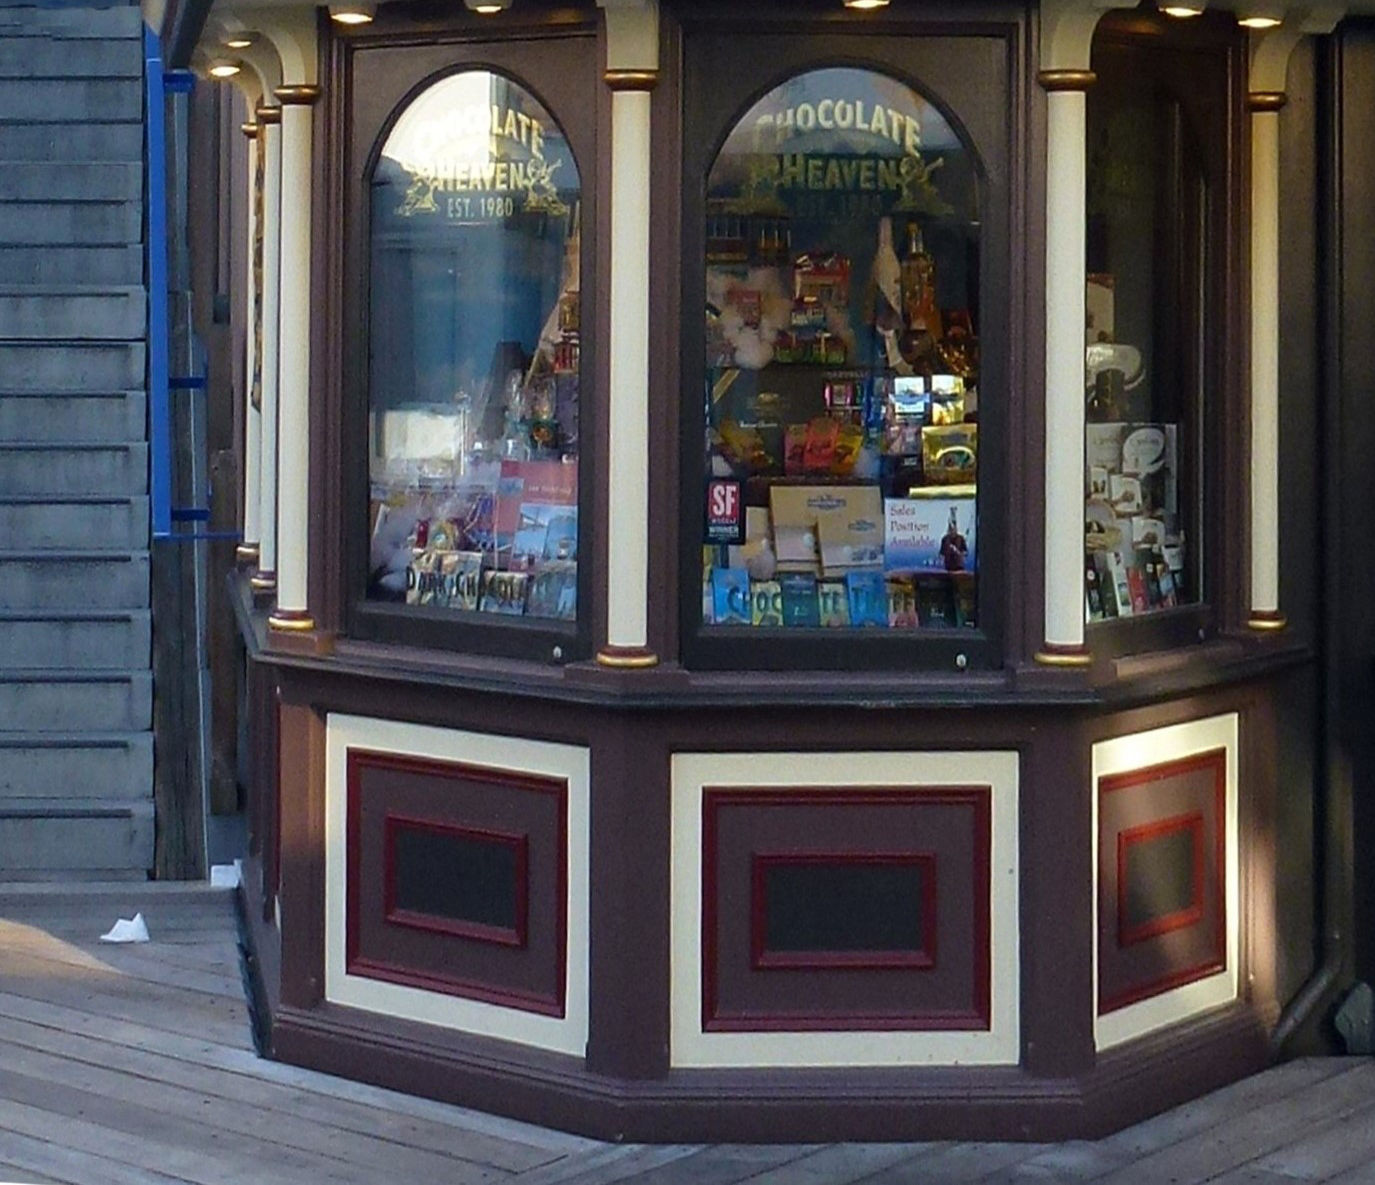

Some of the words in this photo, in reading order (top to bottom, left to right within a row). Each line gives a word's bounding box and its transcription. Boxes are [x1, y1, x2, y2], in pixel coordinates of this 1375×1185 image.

[752, 97, 922, 159] CHOCOLATE
[436, 159, 524, 192] HEAVEN
[780, 155, 899, 191] HEAVEN
[446, 197, 475, 218] EST.
[480, 196, 514, 218] 1980
[712, 484, 737, 517] SF
[890, 503, 916, 517] Sales
